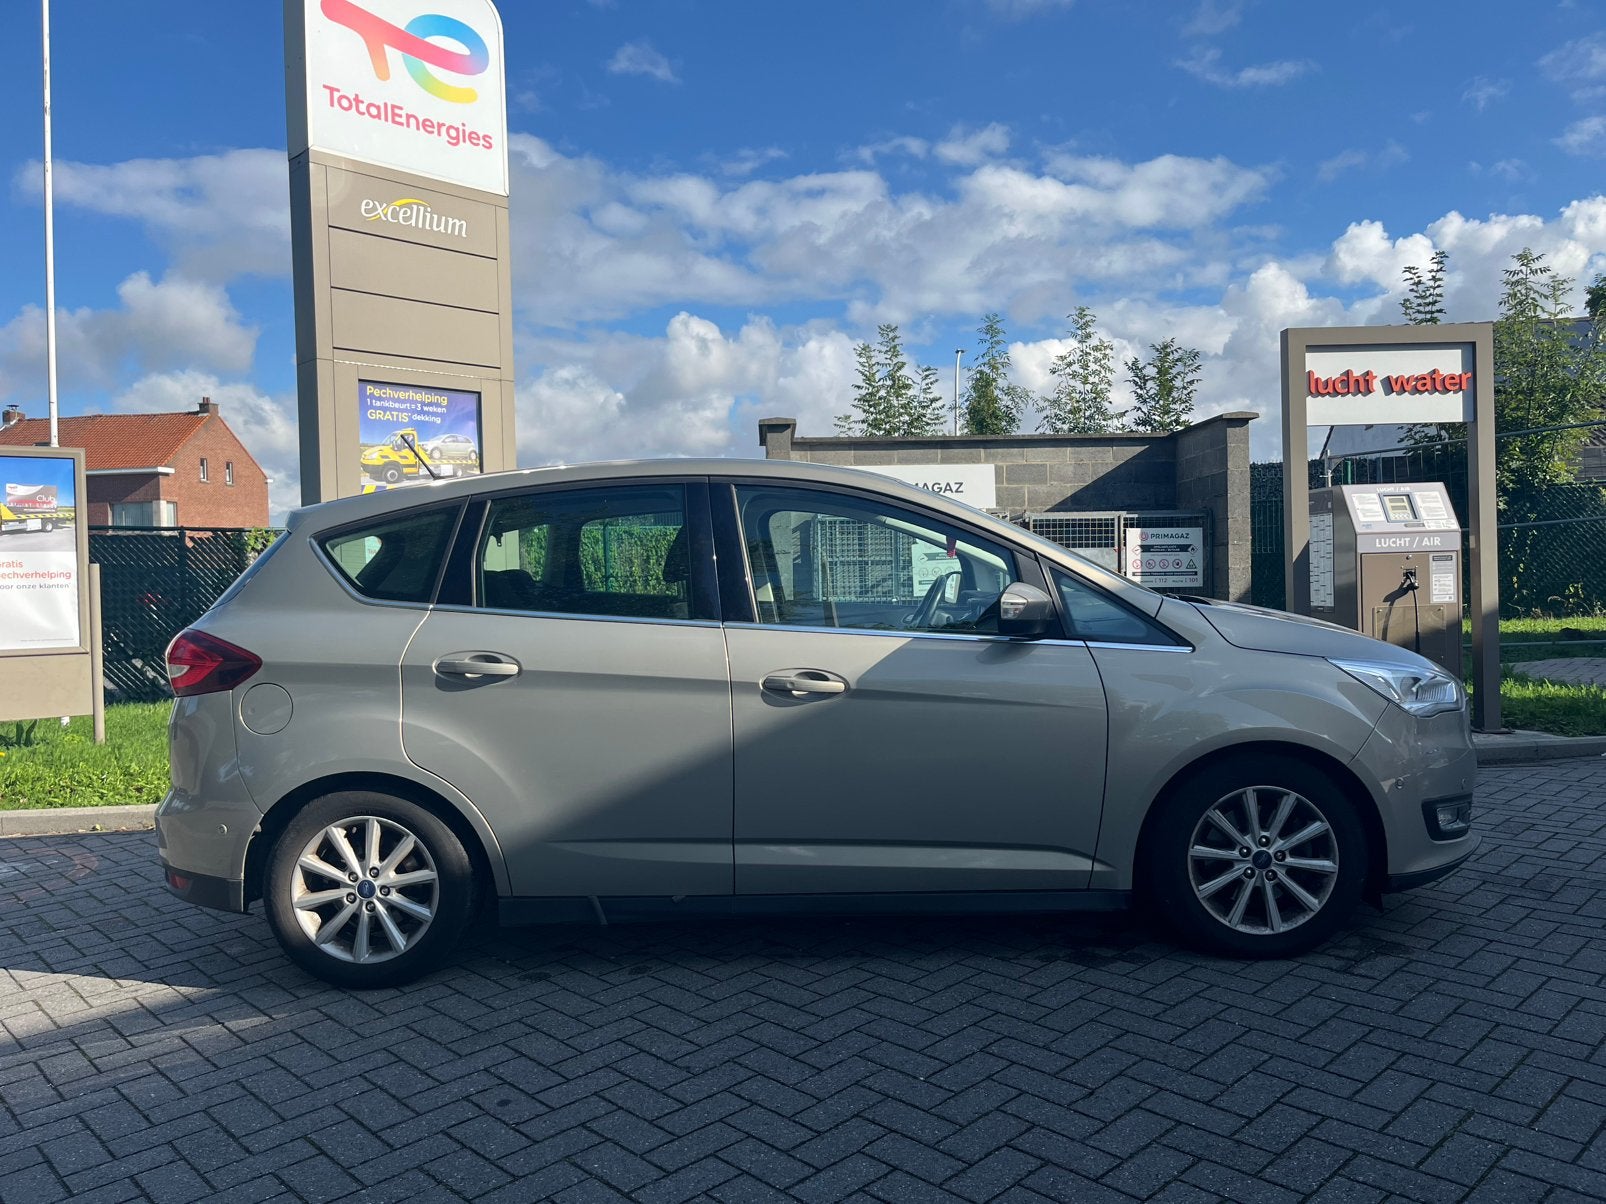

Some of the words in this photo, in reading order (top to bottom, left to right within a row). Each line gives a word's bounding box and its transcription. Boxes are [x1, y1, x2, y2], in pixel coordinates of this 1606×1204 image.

[322, 83, 493, 150] TotalEnergies
[360, 198, 468, 238] excellium
[1308, 369, 1377, 395] lucht
[1388, 368, 1472, 392] water
[366, 386, 448, 405] Pechverhelping
[372, 400, 410, 409] tankbeurt
[416, 403, 421, 411] 3
[423, 405, 447, 413] weken
[412, 414, 441, 424] dekking
[1375, 537, 1411, 548] LUCHT
[1413, 537, 1419, 548] /
[1422, 537, 1441, 546] AIR
[0, 571, 72, 580] echverhelping
